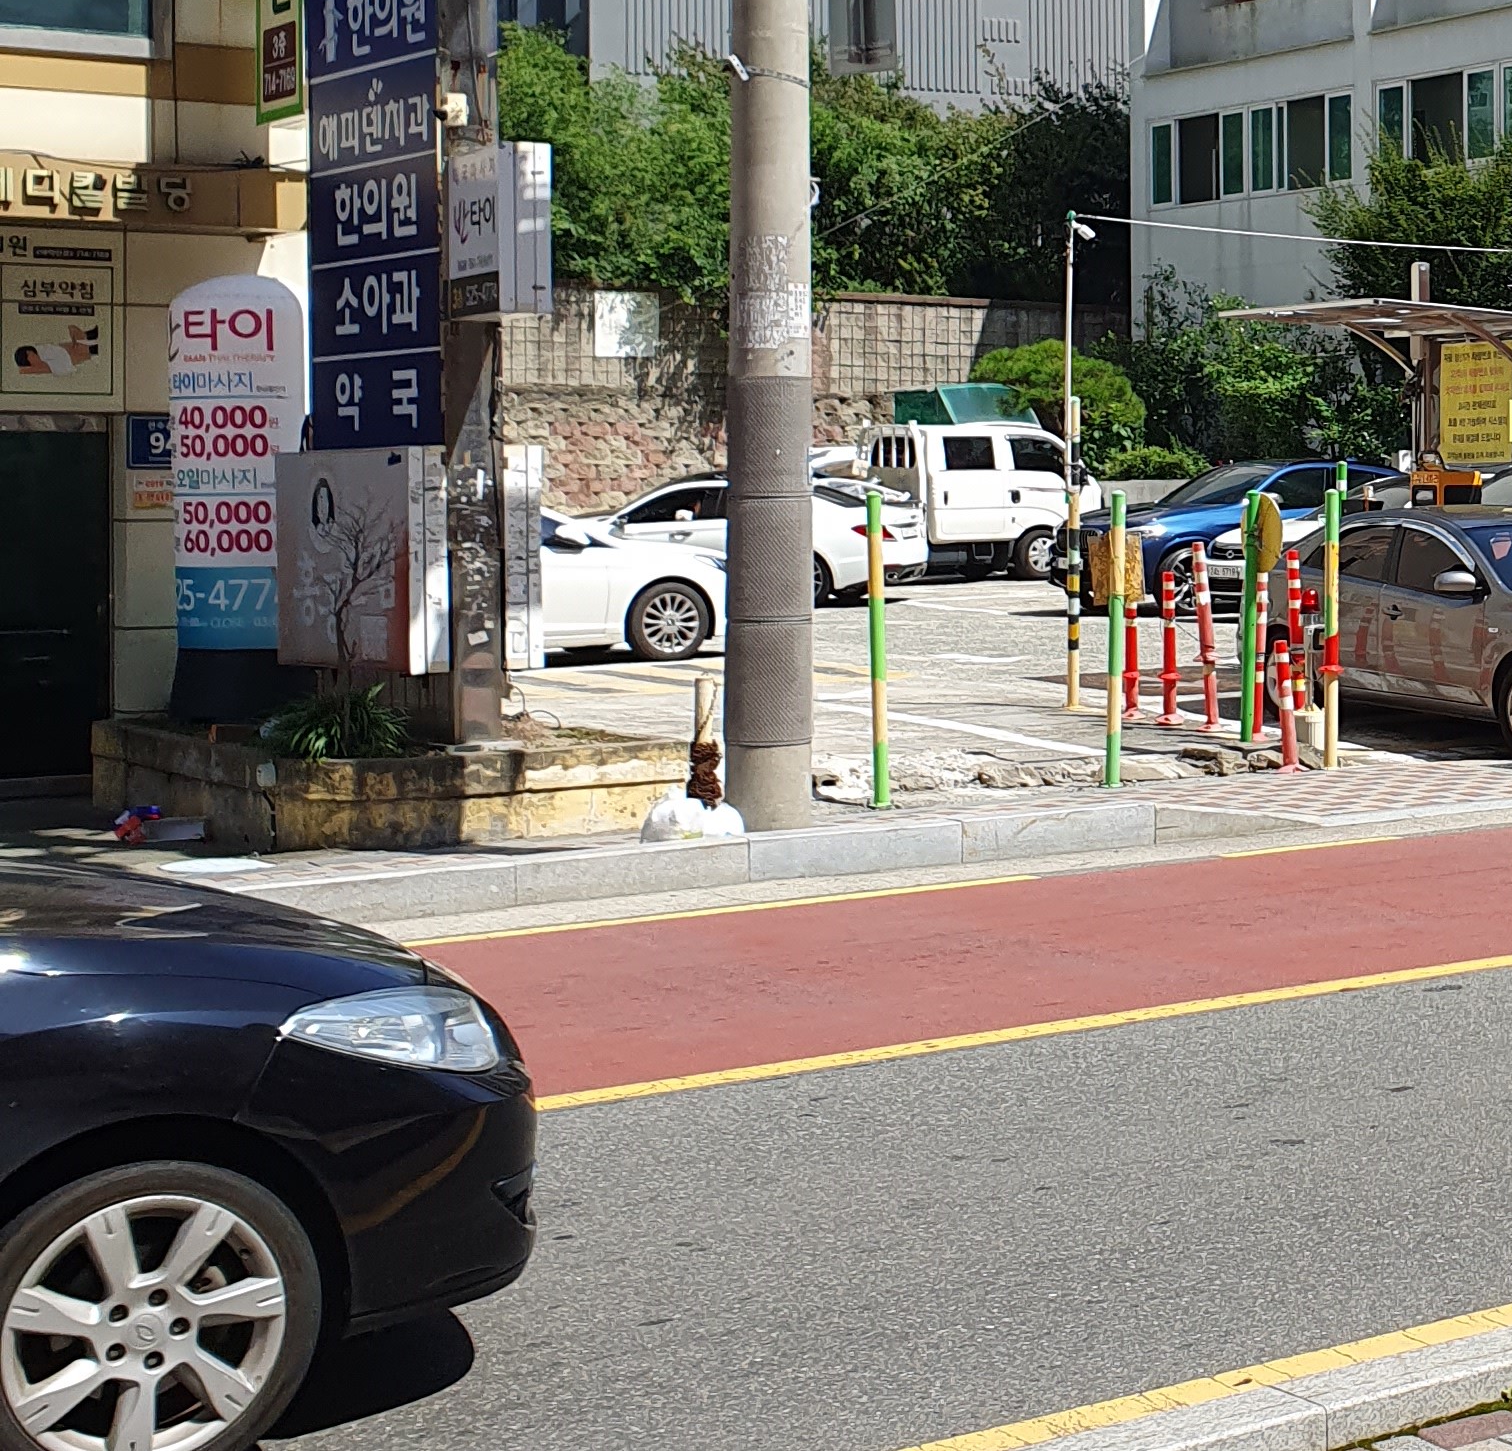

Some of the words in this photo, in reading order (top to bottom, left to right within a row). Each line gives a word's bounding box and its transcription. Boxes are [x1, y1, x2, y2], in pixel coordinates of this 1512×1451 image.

[334, 172, 419, 246] 한의원
[20, 278, 95, 300] 심부약침
[335, 268, 421, 337] 소아과
[172, 370, 254, 394] 타이마사지
[178, 404, 268, 434] 40,000
[180, 432, 269, 462] 50,000
[176, 466, 258, 490] 오일마사지
[182, 500, 273, 529] 50,000
[184, 528, 274, 557] 60,000
